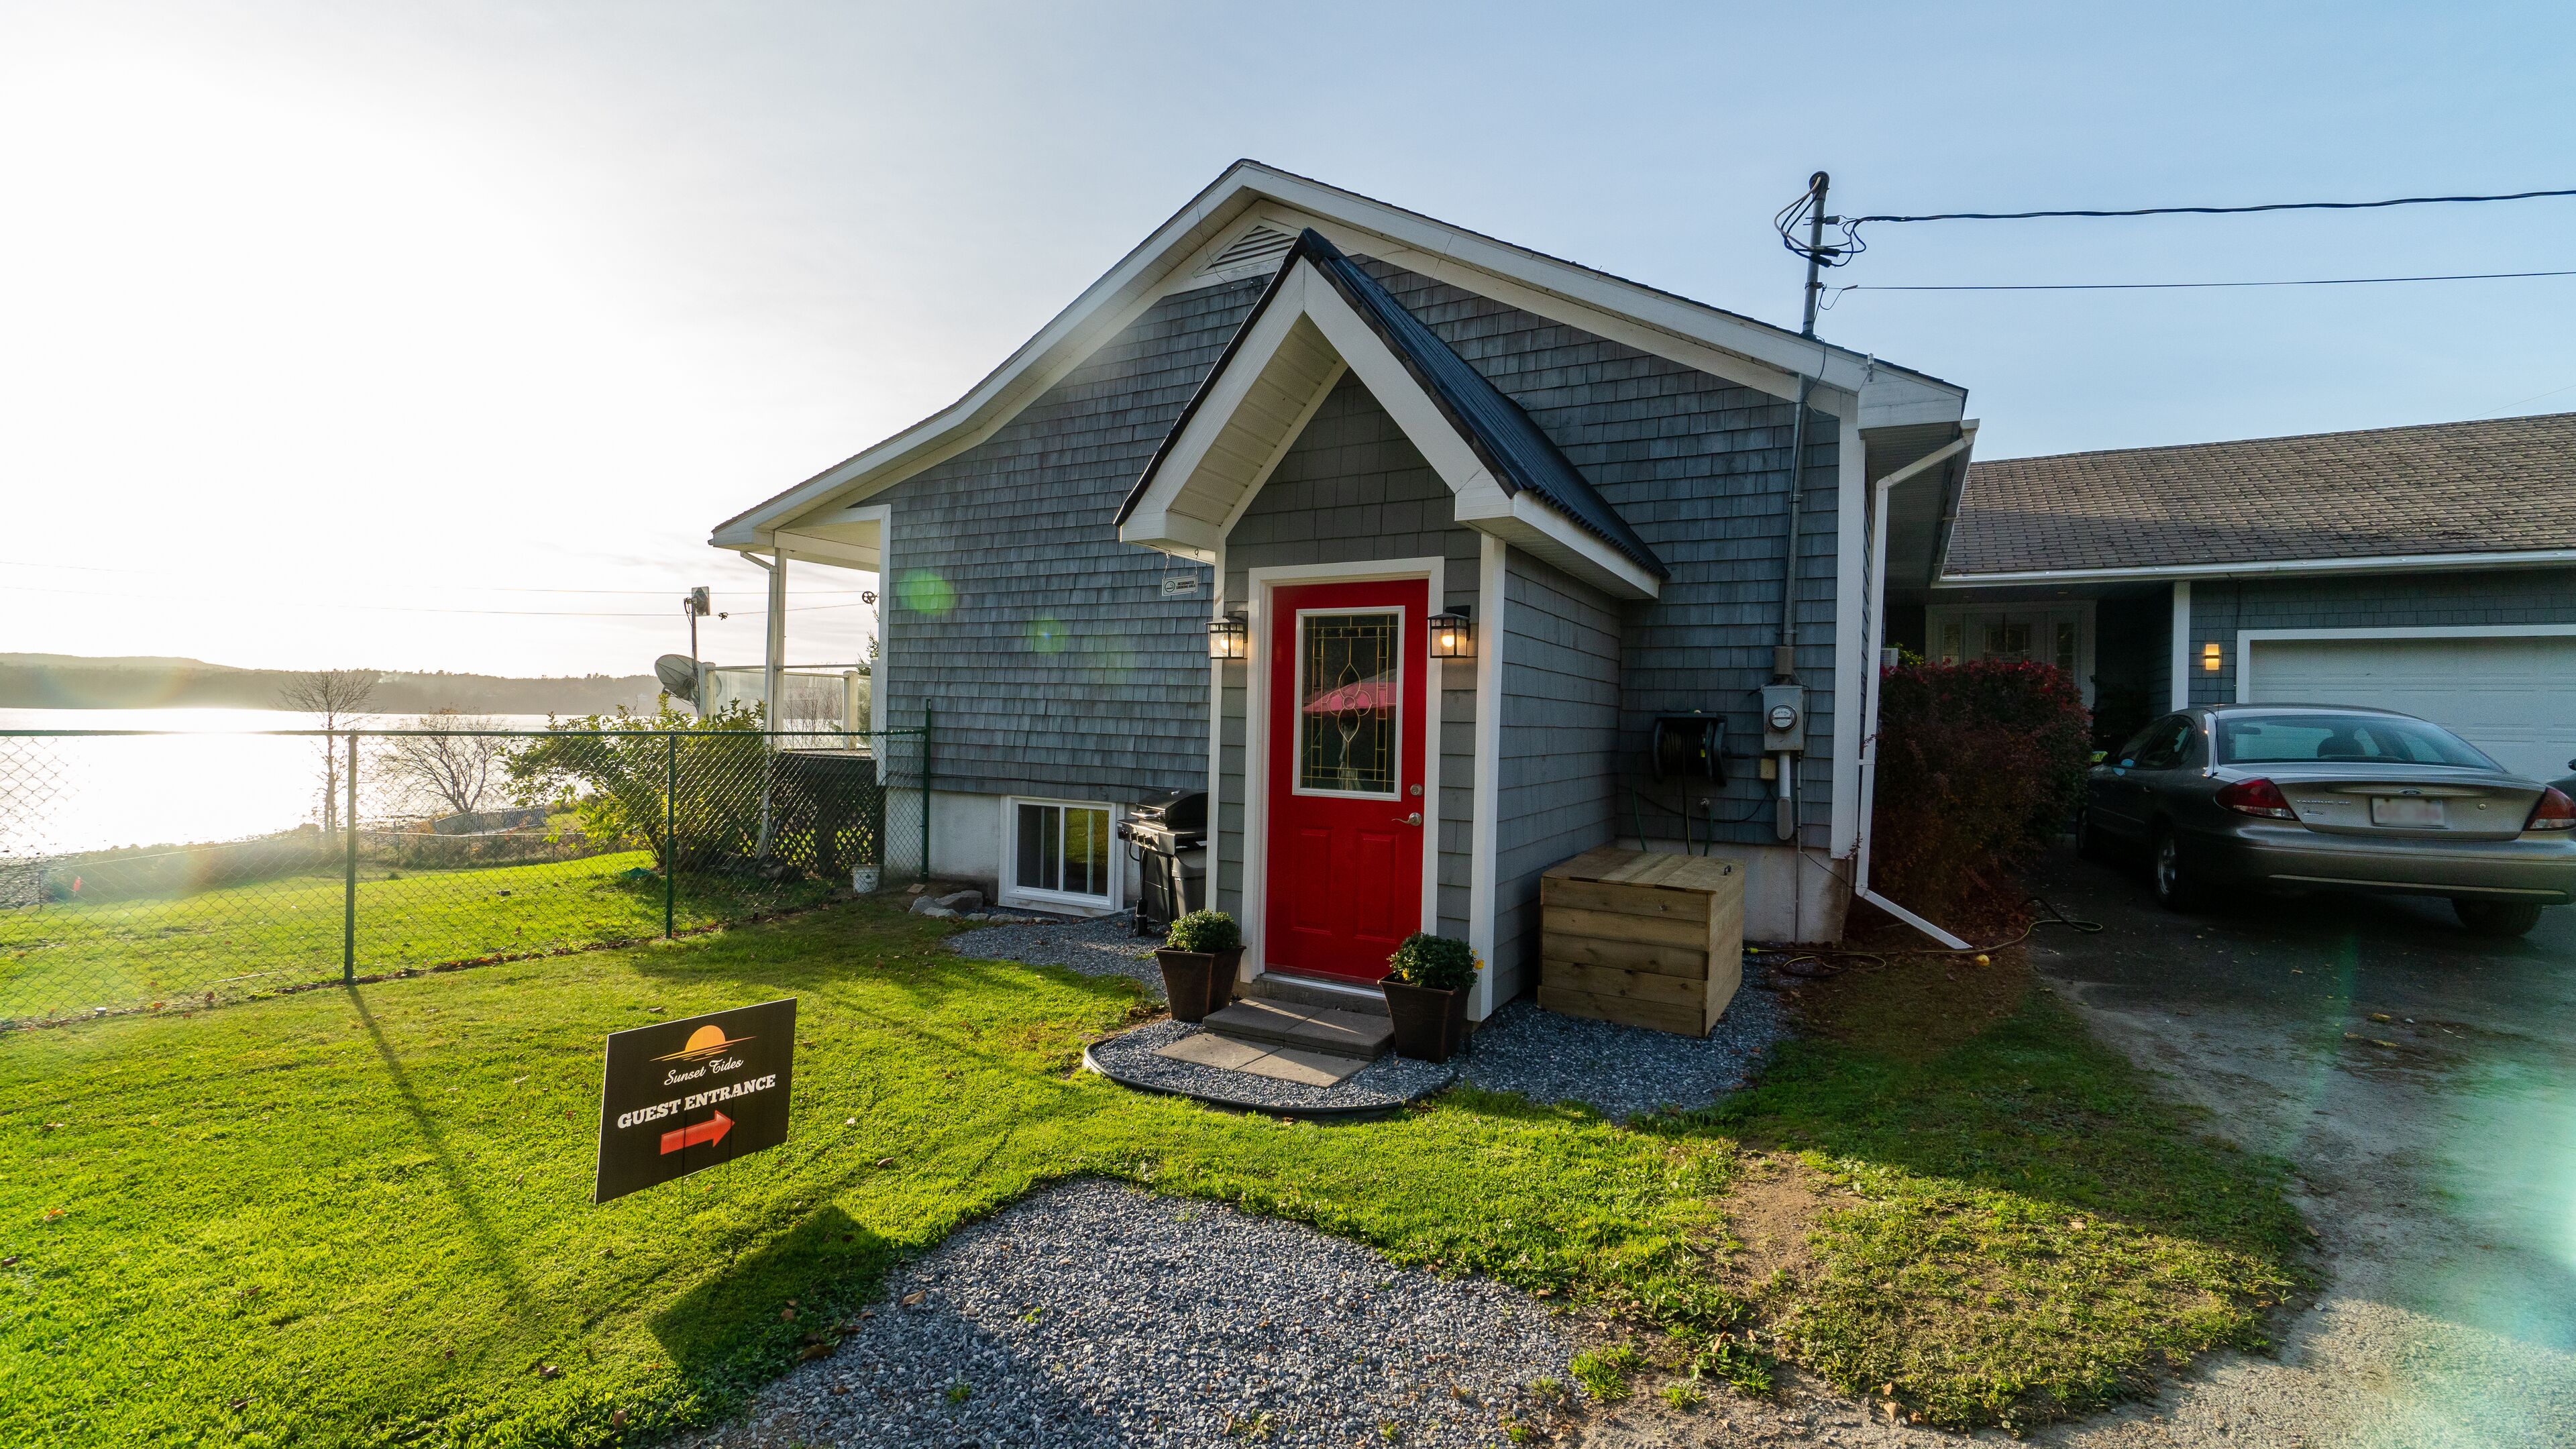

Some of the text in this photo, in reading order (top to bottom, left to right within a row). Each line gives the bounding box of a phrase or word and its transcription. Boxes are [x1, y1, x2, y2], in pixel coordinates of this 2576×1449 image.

[663, 1057, 744, 1085] Sunset Tides
[617, 1074, 776, 1128] GUEST ENTRANCE
